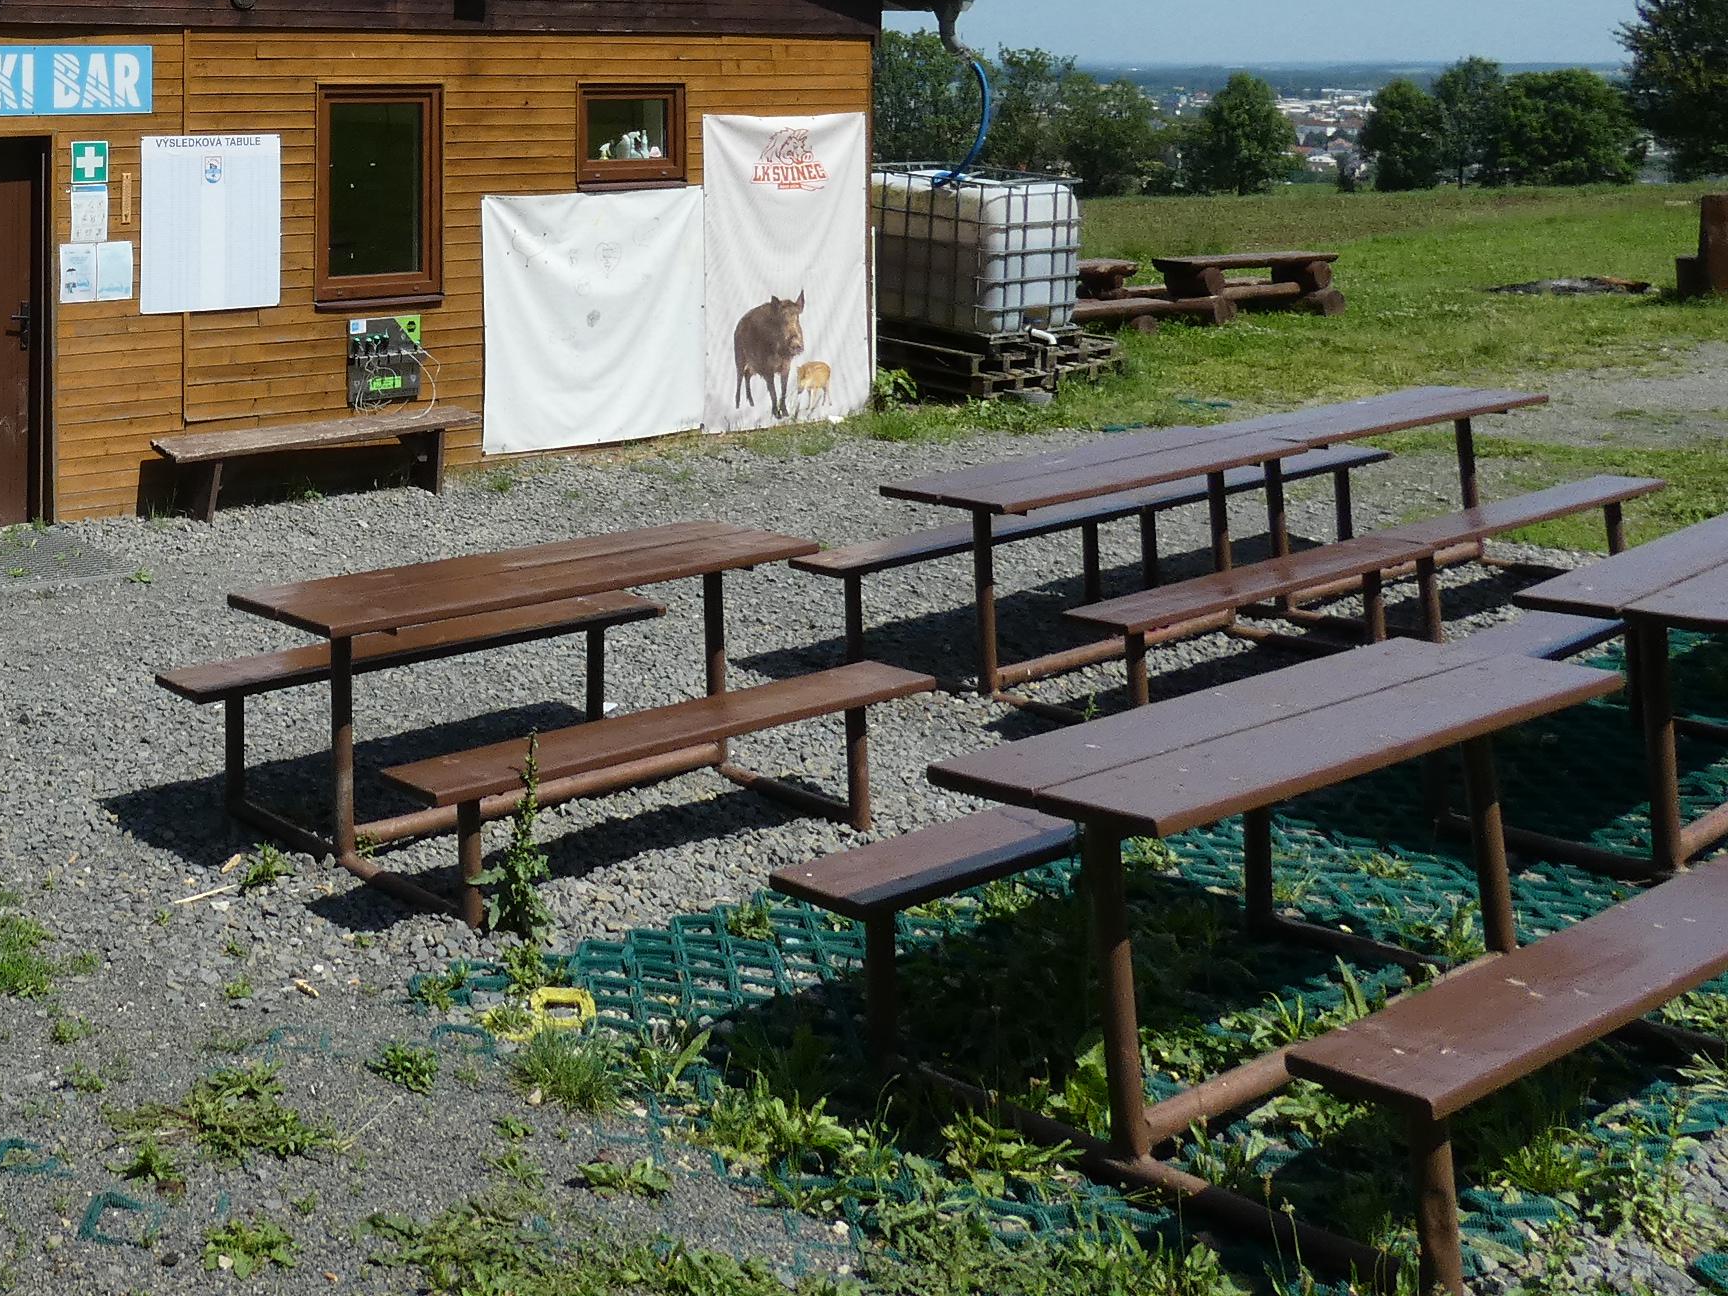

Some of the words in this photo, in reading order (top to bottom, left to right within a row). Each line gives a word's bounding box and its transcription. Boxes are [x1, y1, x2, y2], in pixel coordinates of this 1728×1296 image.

[53, 52, 141, 109] BAR
[155, 135, 223, 148] VÝSLEDKOVÁ
[225, 136, 261, 146] TABULE
[752, 165, 771, 182] LK
[772, 163, 826, 182] SVINEC
